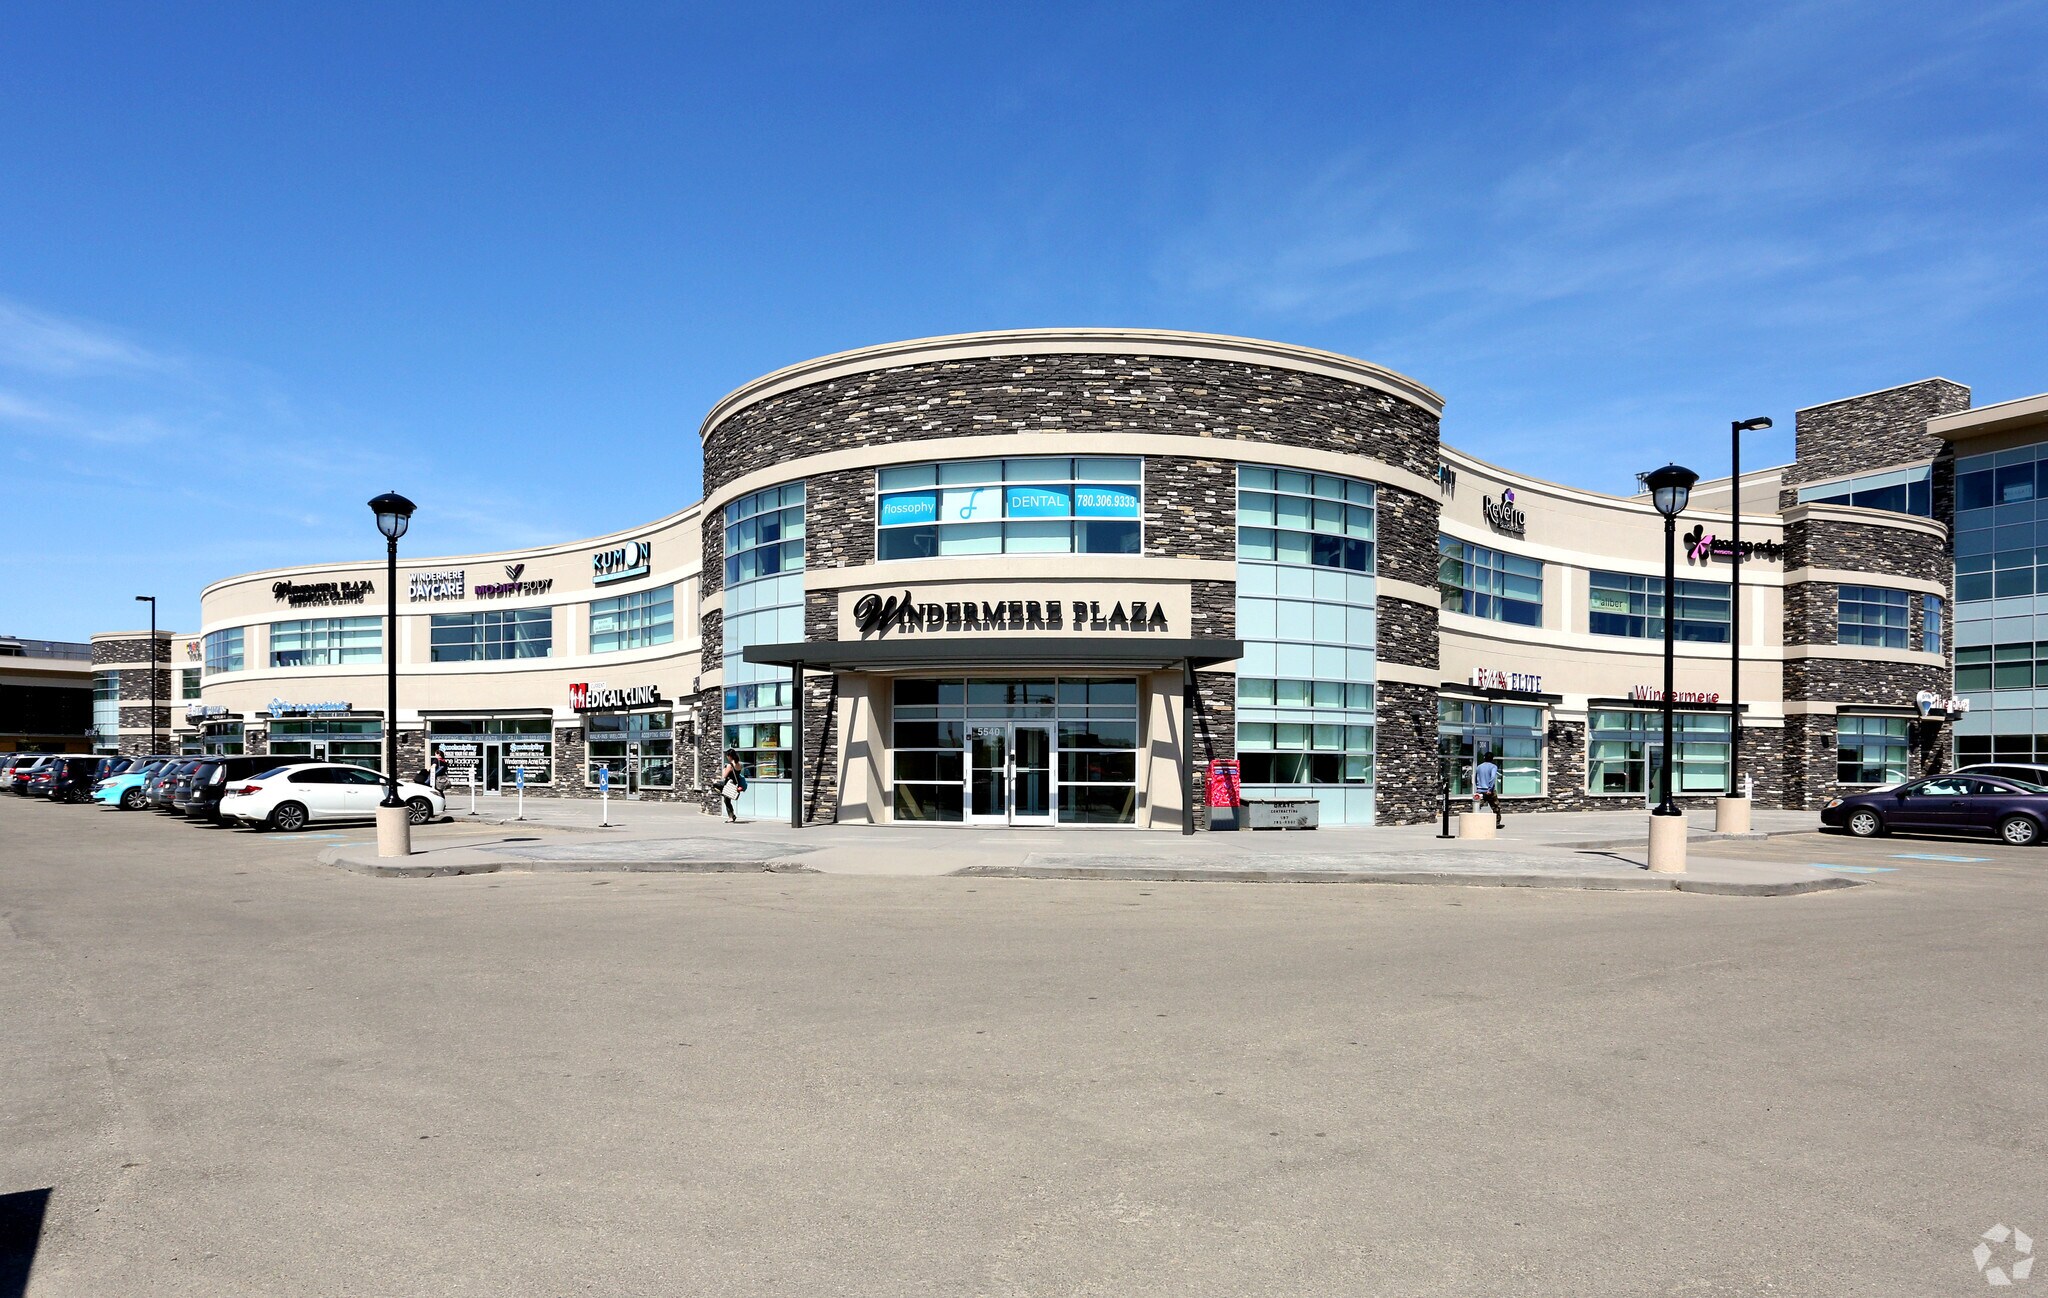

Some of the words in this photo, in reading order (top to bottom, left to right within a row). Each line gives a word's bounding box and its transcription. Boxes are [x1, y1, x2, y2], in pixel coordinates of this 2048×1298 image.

[884, 502, 934, 514] flossophy
[1012, 495, 1064, 508] DENTAL
[1077, 494, 1135, 508] 780.306.9333
[592, 541, 651, 569] KUMON
[408, 570, 463, 581] WINDERMERE
[340, 580, 375, 592] PLAZA
[408, 582, 463, 597] DAYCARE
[475, 582, 520, 594] MODIFY
[522, 579, 551, 590] BODY
[852, 589, 1063, 632] WINDERMERE
[1072, 600, 1168, 624] PLAZA
[1512, 673, 1542, 692] ELITE
[569, 683, 623, 709] MEDICAL
[624, 685, 655, 705] CLINIC
[1635, 685, 1720, 703] Winermere
[977, 727, 1000, 736] 5540
